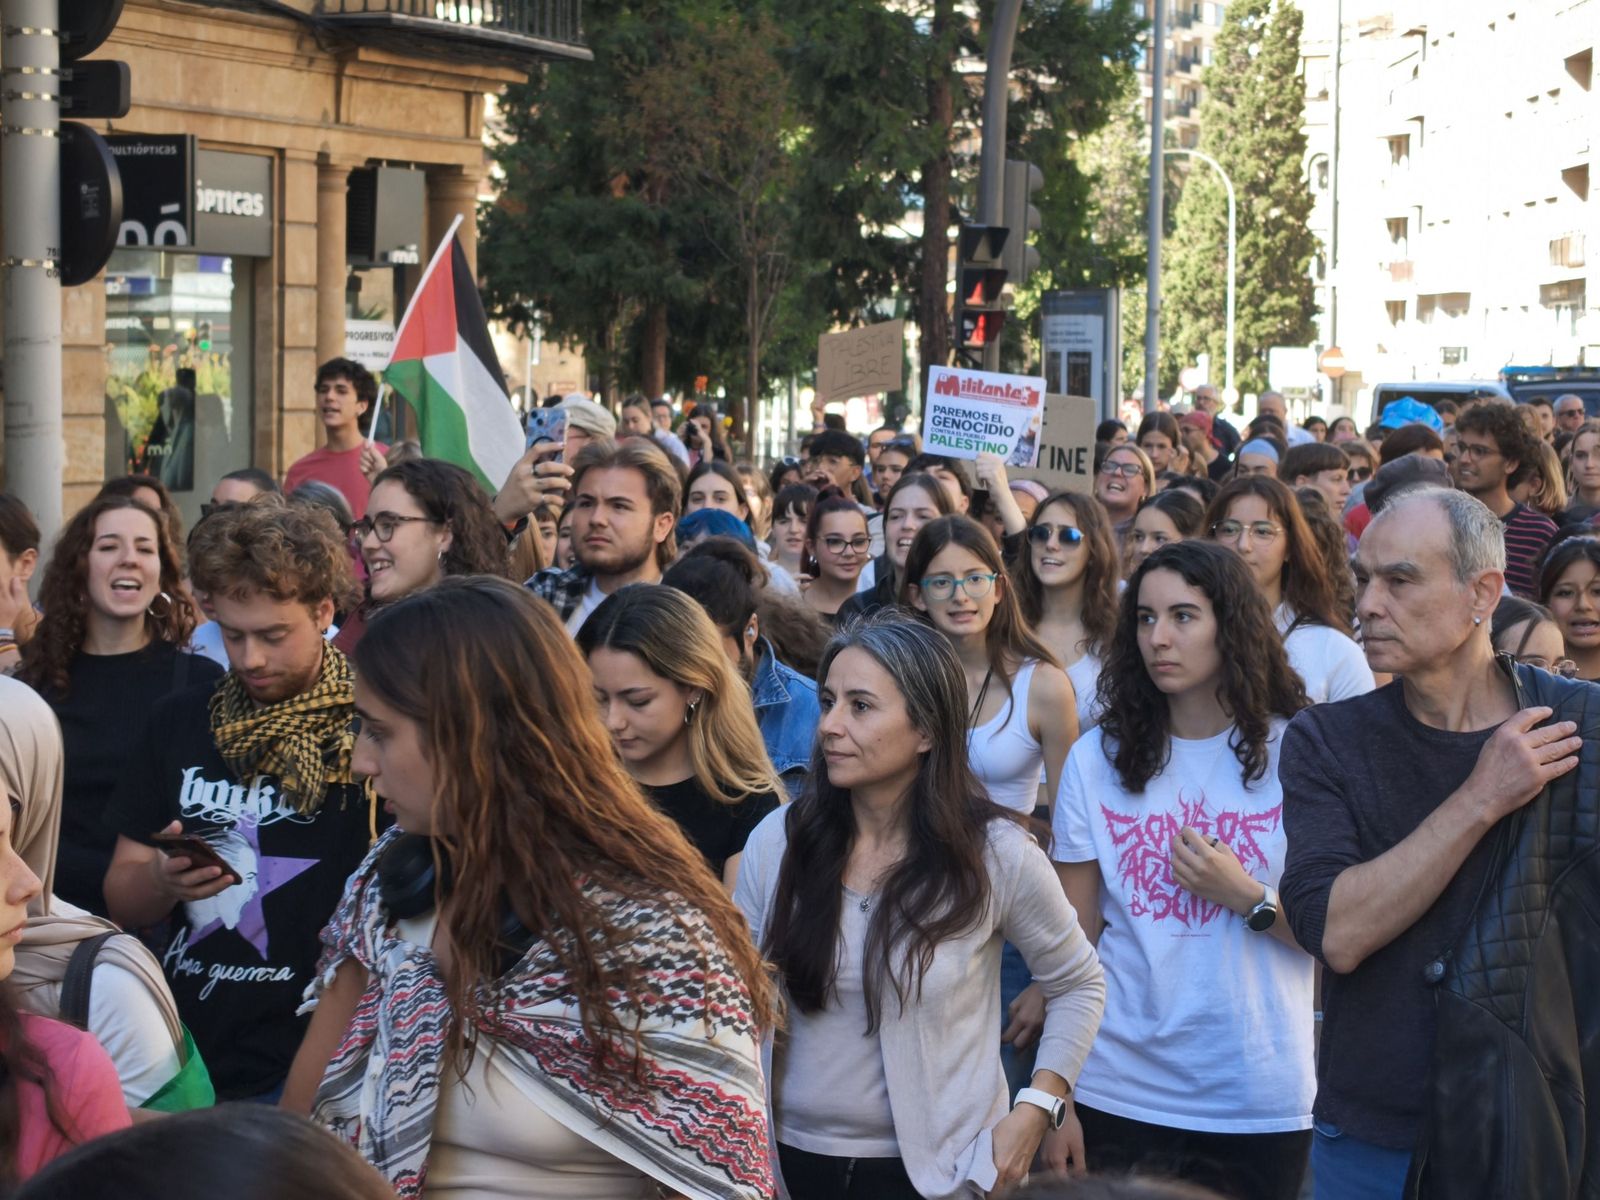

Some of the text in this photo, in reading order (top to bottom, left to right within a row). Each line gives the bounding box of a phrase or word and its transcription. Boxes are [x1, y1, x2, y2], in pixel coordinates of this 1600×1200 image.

[933, 405, 1004, 424] PAREMOS EL
[930, 427, 955, 436] CONTRA
[963, 432, 986, 440] PUEBLO
[931, 415, 1015, 438] GENOCIDIO
[929, 433, 1008, 455] PALESTINO
